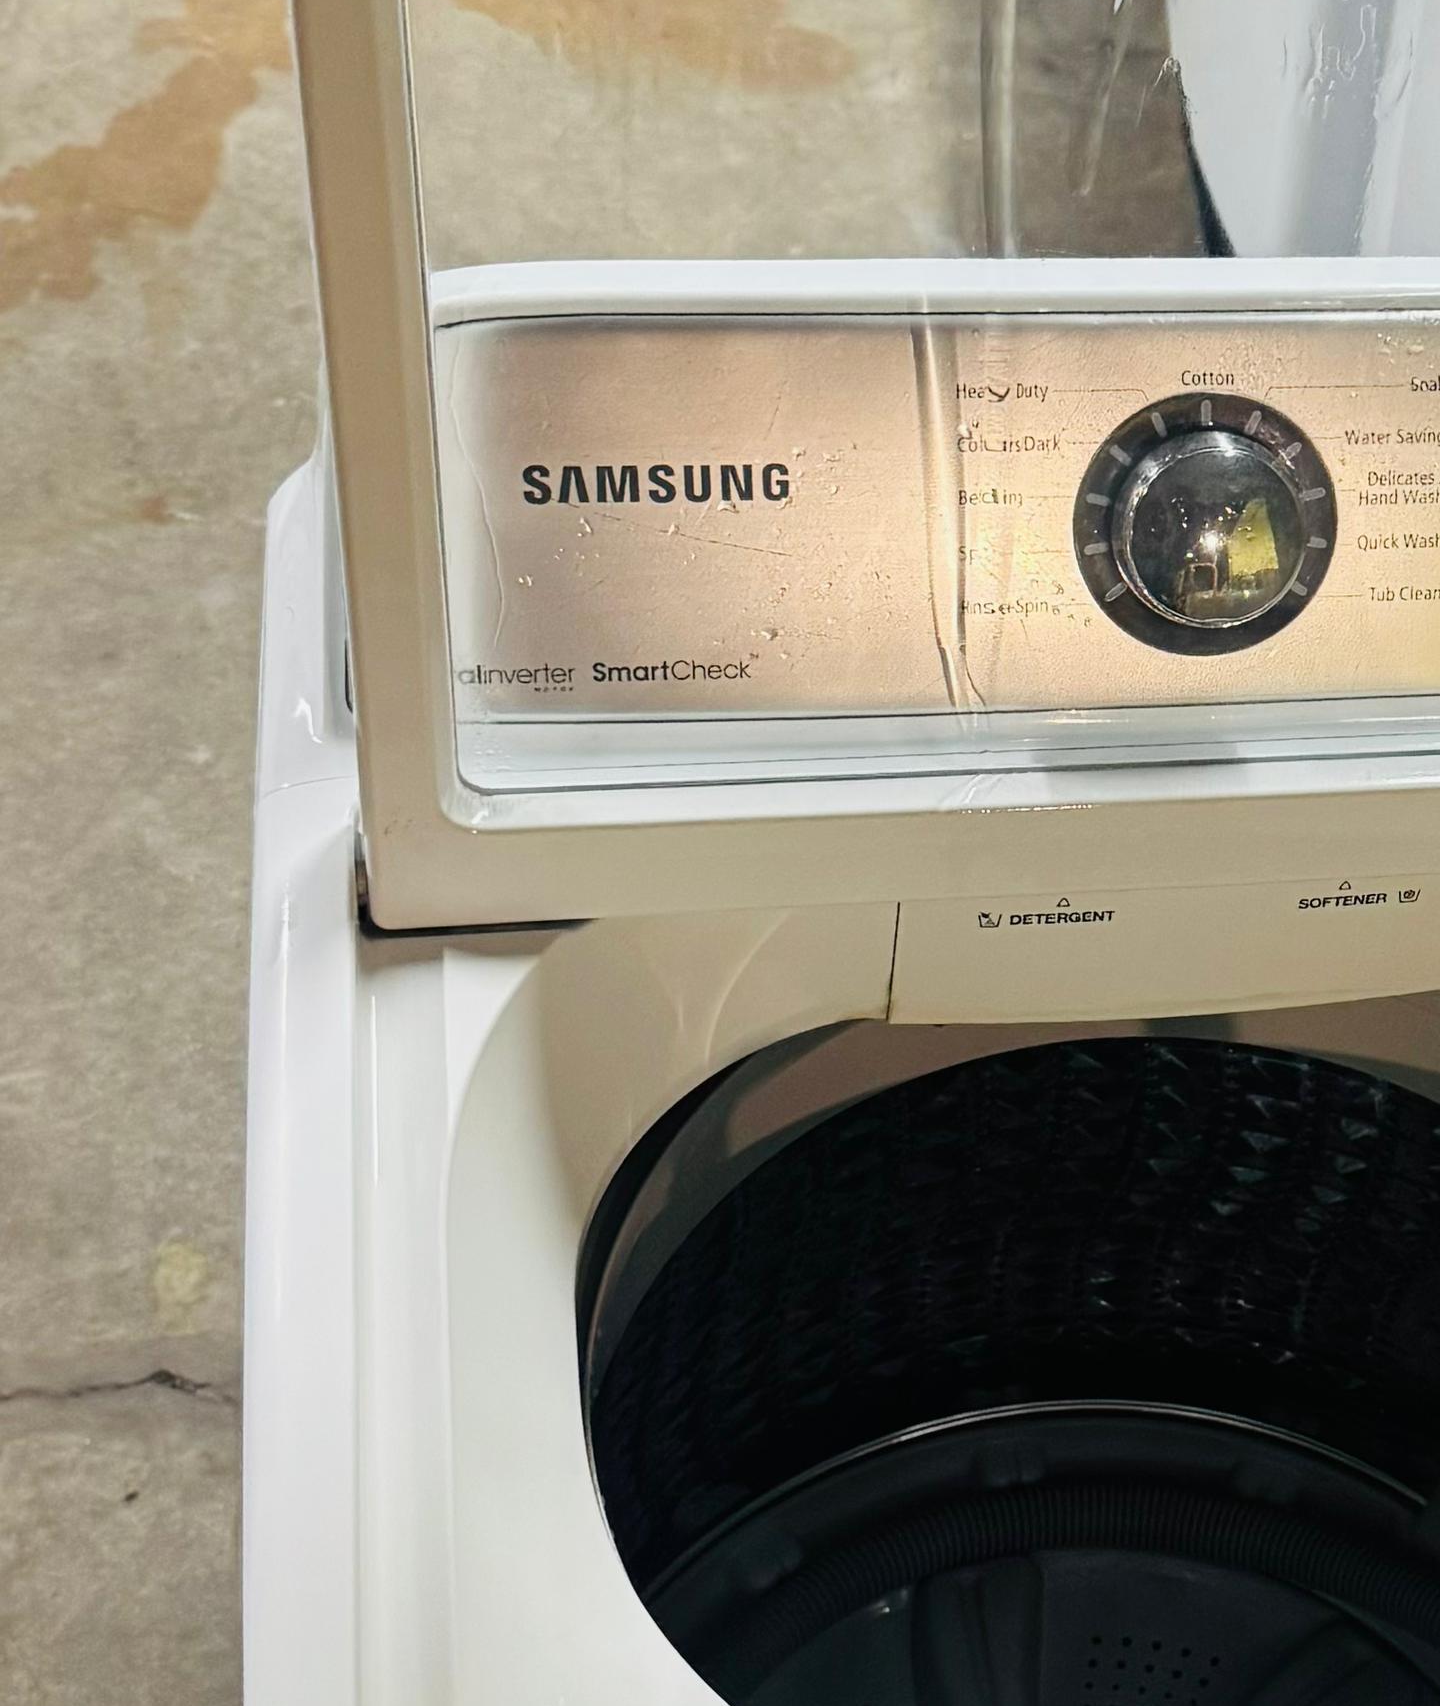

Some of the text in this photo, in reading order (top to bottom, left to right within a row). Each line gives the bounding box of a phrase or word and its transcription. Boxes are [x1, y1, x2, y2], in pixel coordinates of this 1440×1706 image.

[1181, 369, 1235, 388] Cotton
[1015, 383, 1049, 403] Duty
[1345, 429, 1391, 446] Water
[522, 463, 790, 505] SAMSUNG
[1367, 470, 1435, 487] Delicates
[1359, 489, 1398, 506] Hand
[1357, 533, 1400, 552] Quick
[1369, 586, 1396, 602] Tub
[592, 659, 752, 684] SmartCheck
[1298, 892, 1388, 910] SOFTENER
[1008, 909, 1116, 926] DETERGENT
